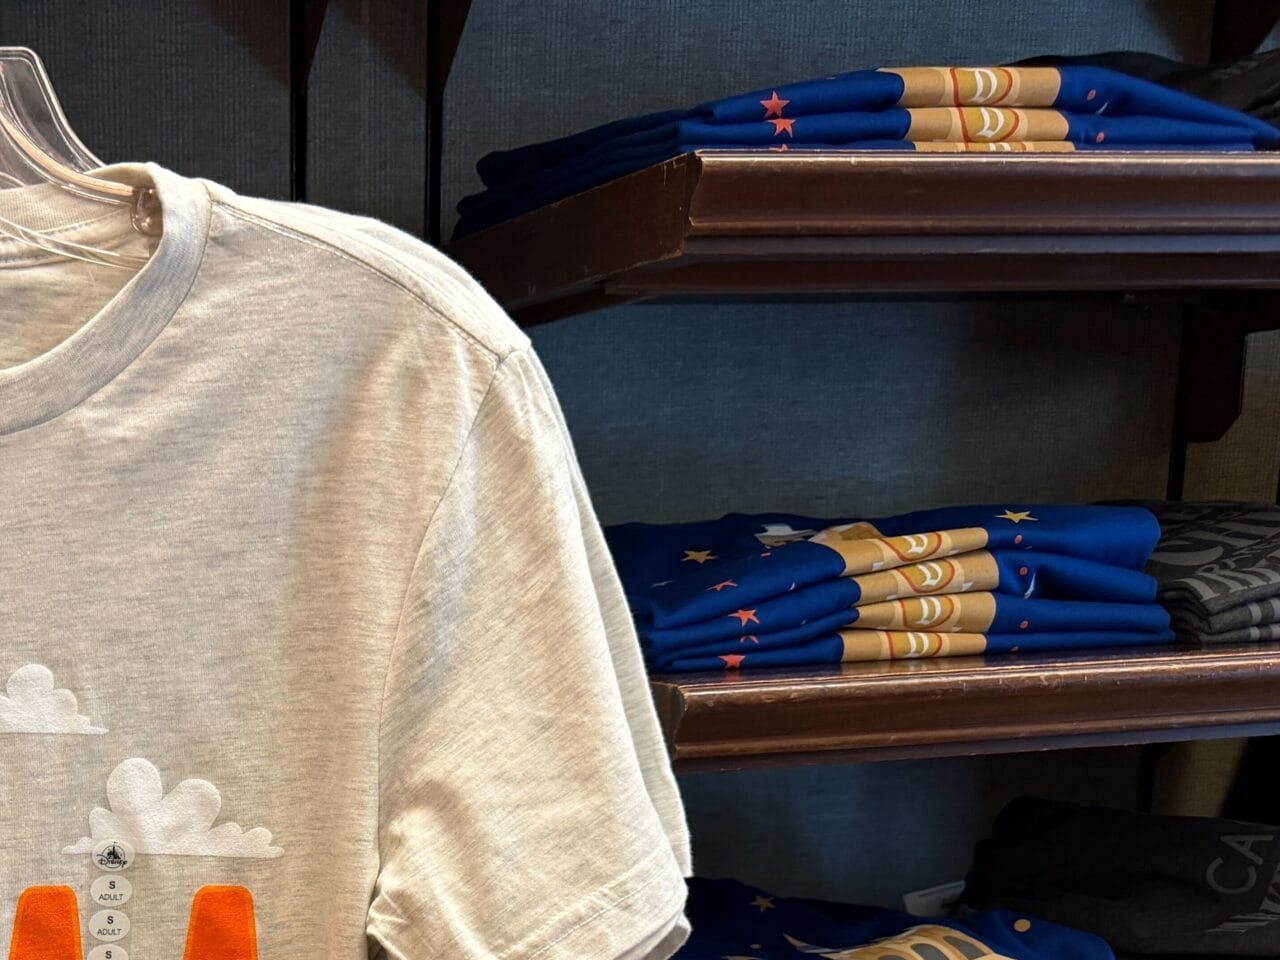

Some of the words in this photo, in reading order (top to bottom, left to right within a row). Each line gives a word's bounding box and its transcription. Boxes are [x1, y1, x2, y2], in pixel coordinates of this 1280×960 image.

[109, 881, 116, 889] S
[99, 893, 124, 901] ADULT
[107, 916, 114, 924] S
[97, 928, 122, 936] ADULT
[105, 950, 112, 959] S
